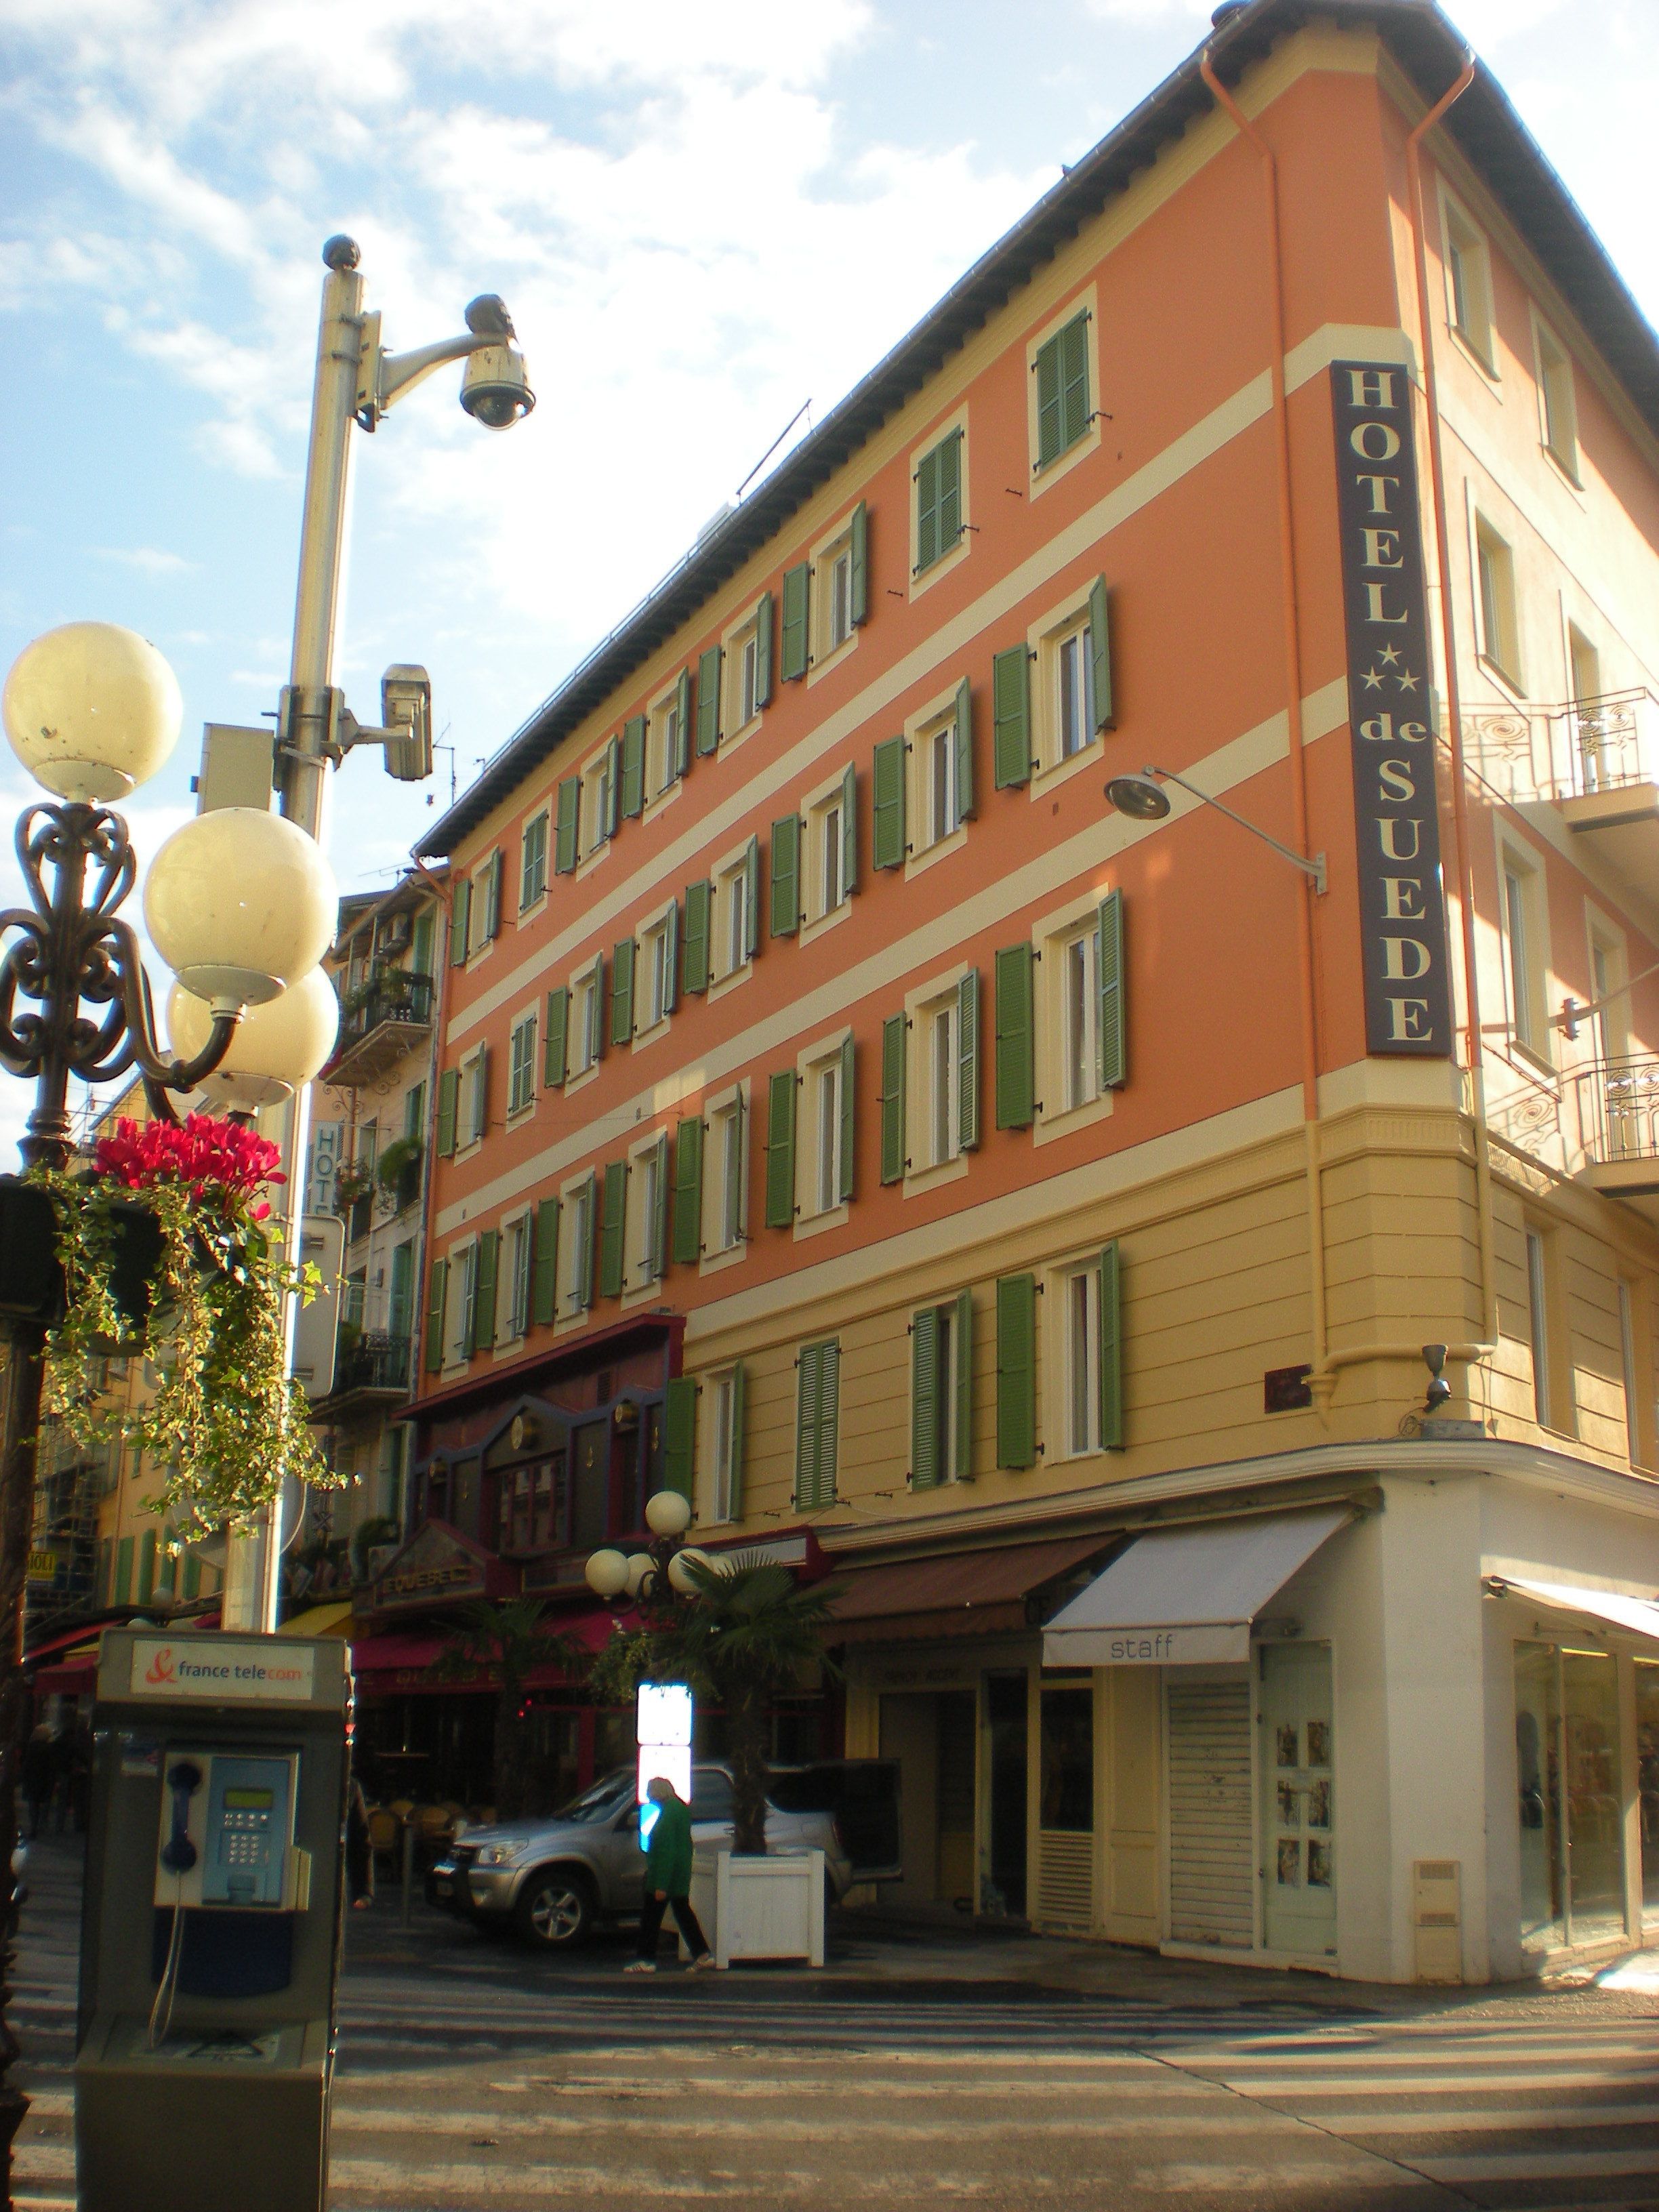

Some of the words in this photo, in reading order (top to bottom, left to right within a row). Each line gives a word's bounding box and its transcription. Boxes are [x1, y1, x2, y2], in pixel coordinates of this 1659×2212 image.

[1346, 369, 1408, 623] HOTEL
[1359, 712, 1427, 742] de
[1374, 758, 1433, 1042] SUEDE
[1111, 1633, 1172, 1658] staff
[178, 1661, 230, 1678] france
[234, 1664, 301, 1681] telecom
